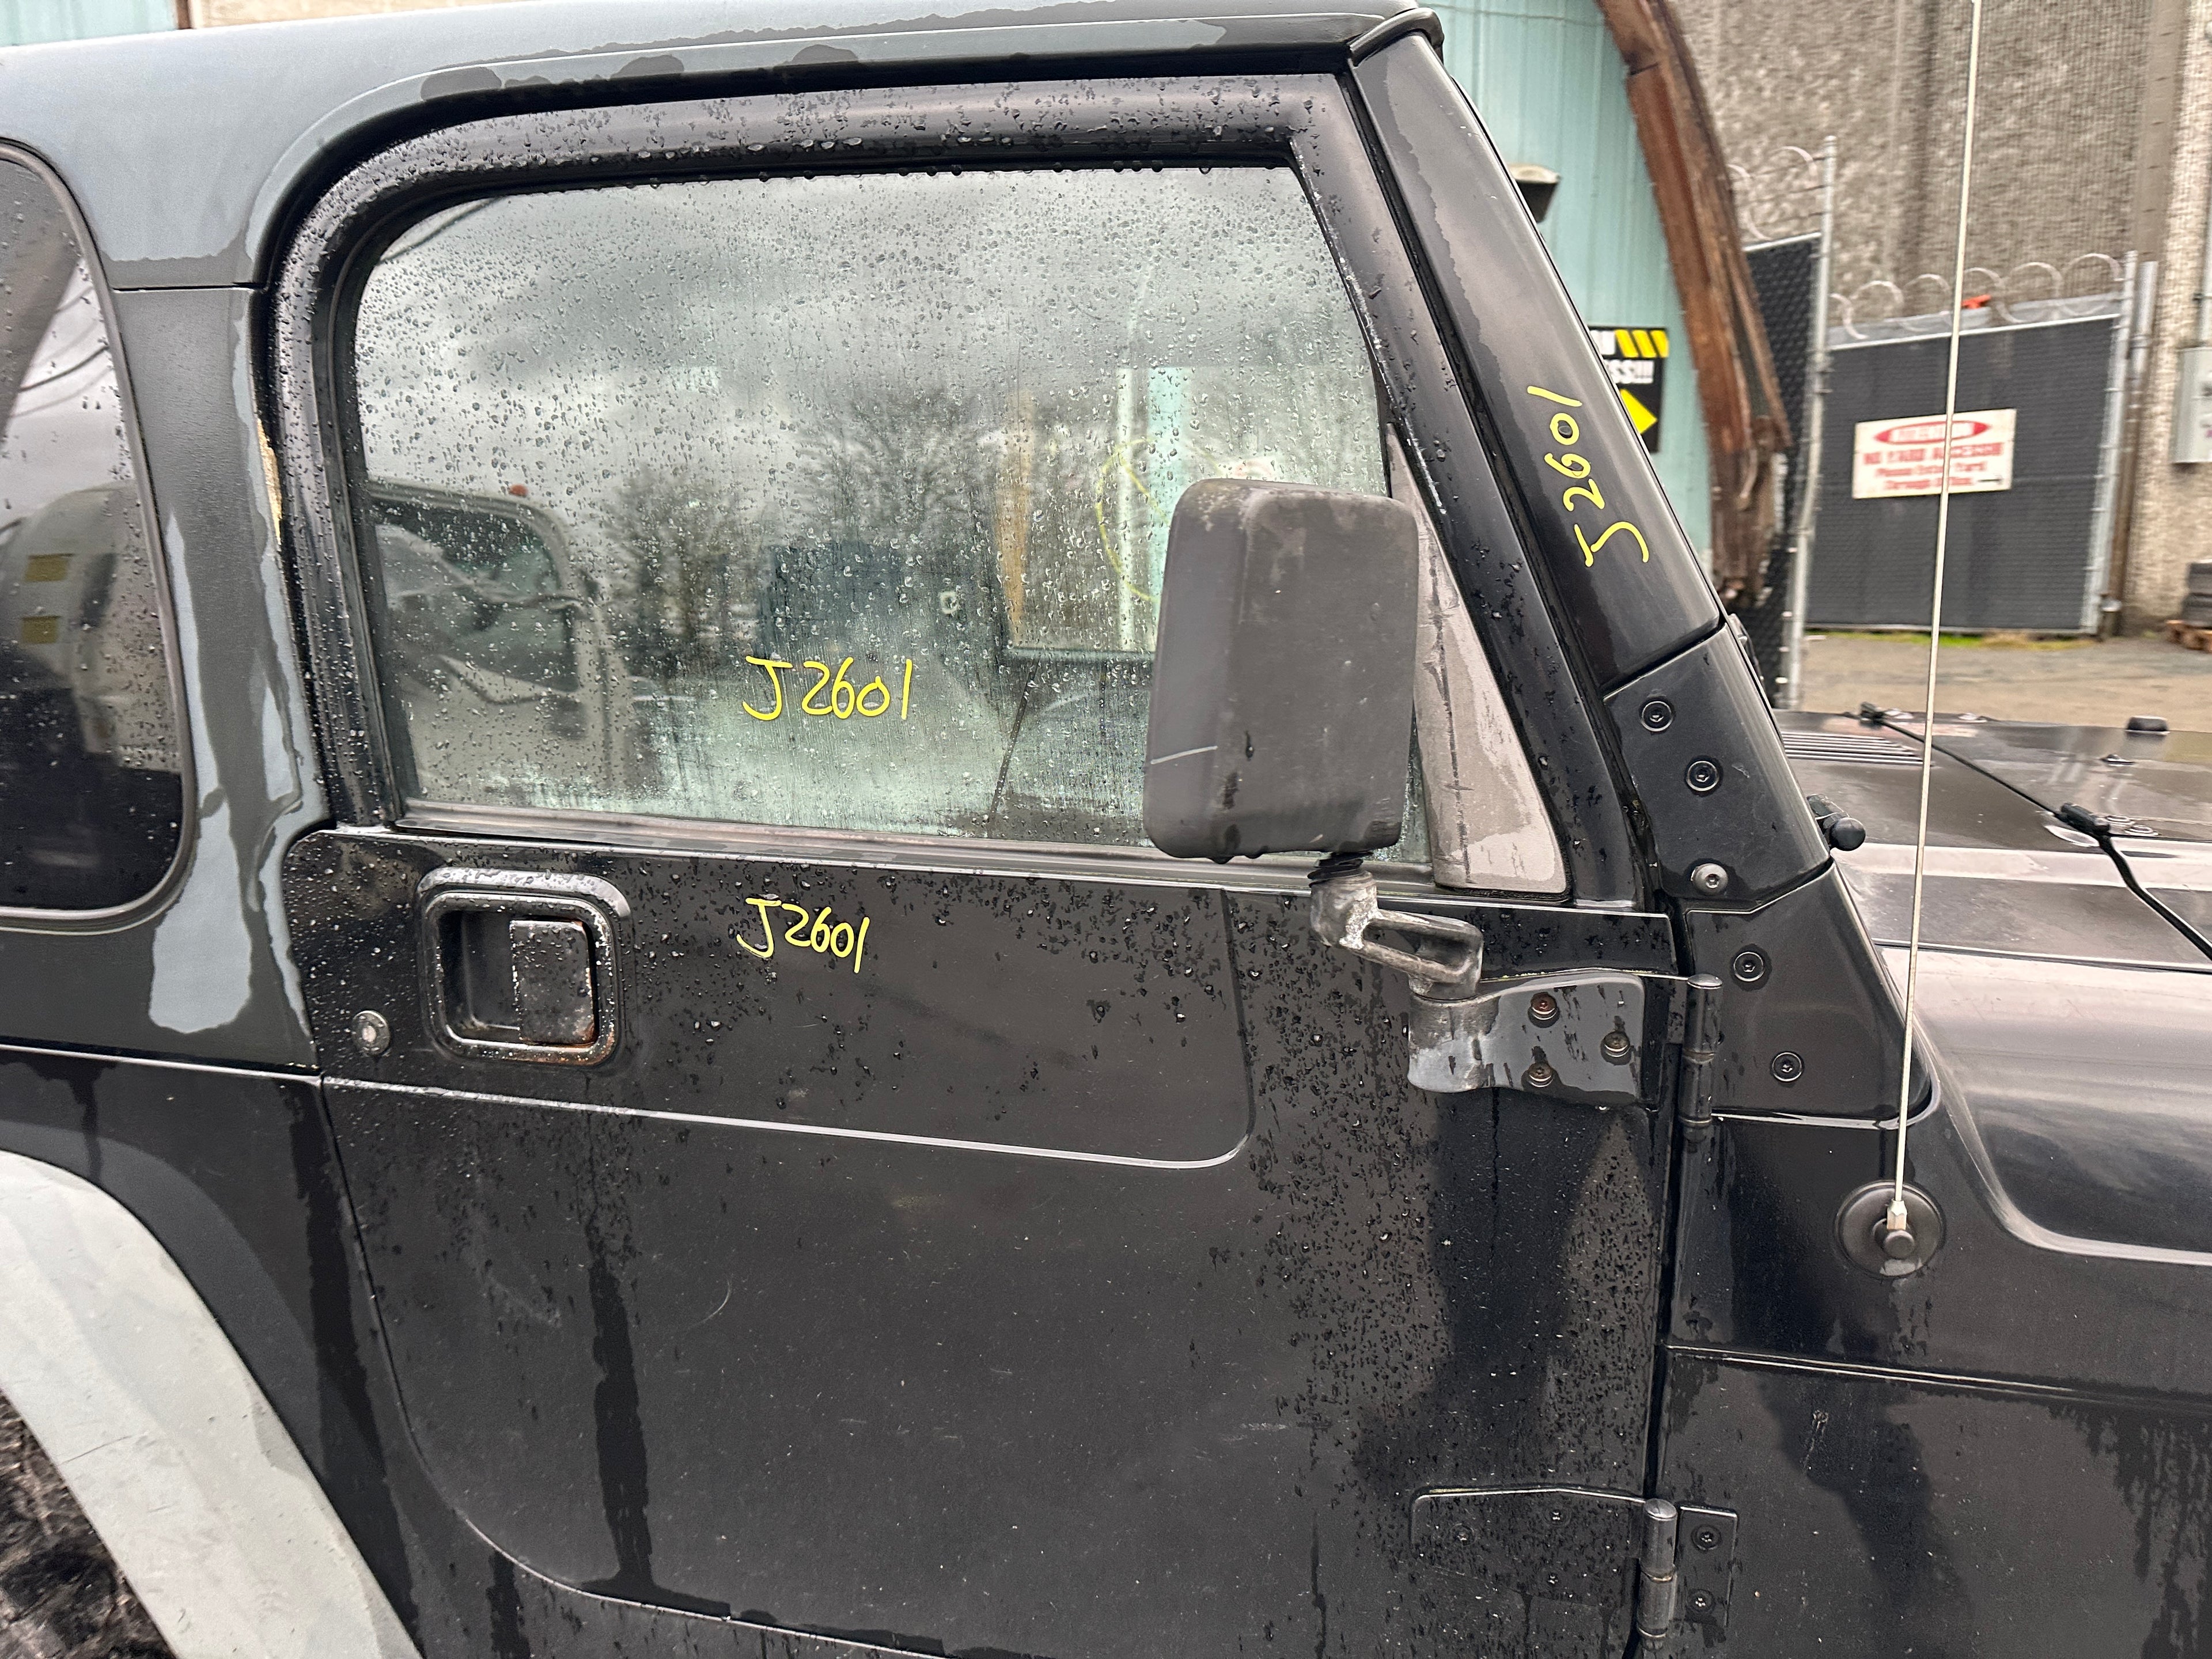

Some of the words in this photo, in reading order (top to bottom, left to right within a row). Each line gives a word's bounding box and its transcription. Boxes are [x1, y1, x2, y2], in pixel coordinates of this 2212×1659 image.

[1527, 385, 1649, 567] J2601
[742, 656, 913, 721] J2601
[736, 897, 870, 974] J2601
